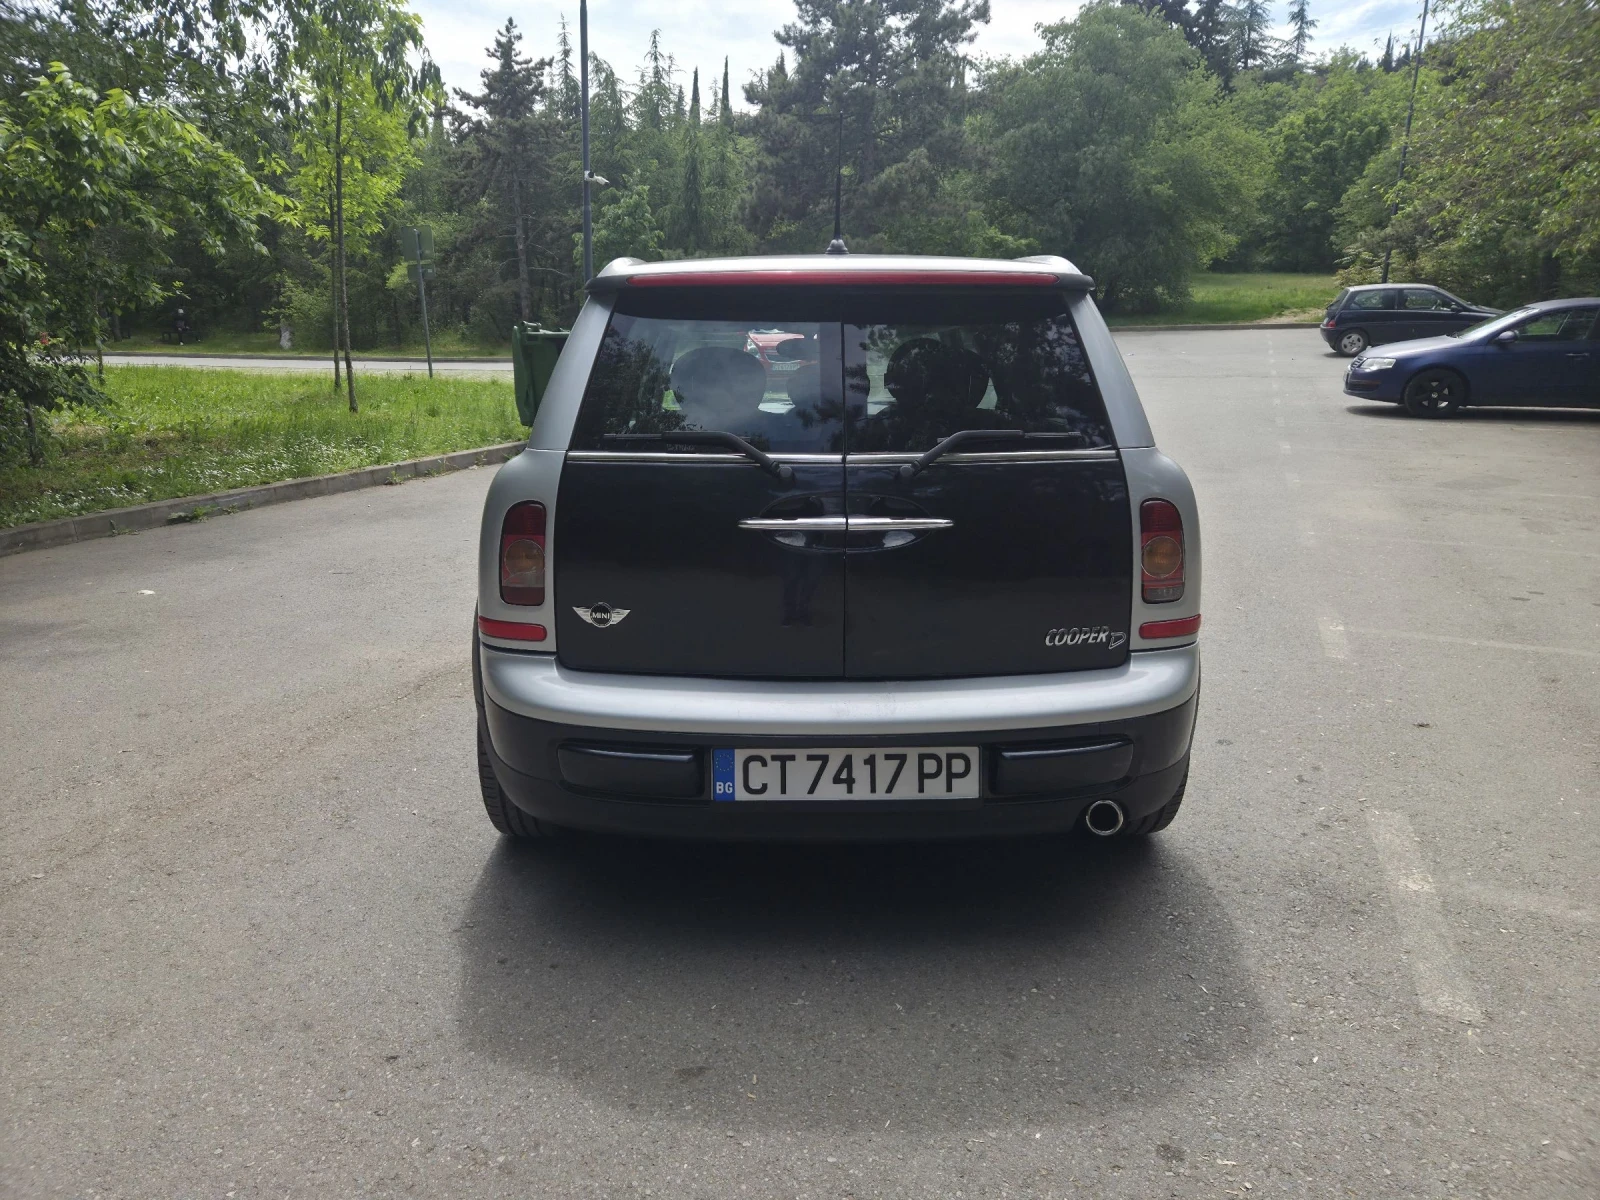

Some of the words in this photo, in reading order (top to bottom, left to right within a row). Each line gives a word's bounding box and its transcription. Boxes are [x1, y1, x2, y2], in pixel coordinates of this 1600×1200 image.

[1045, 625, 1110, 646] COOPER
[1108, 631, 1127, 650] D
[716, 782, 733, 794] BG
